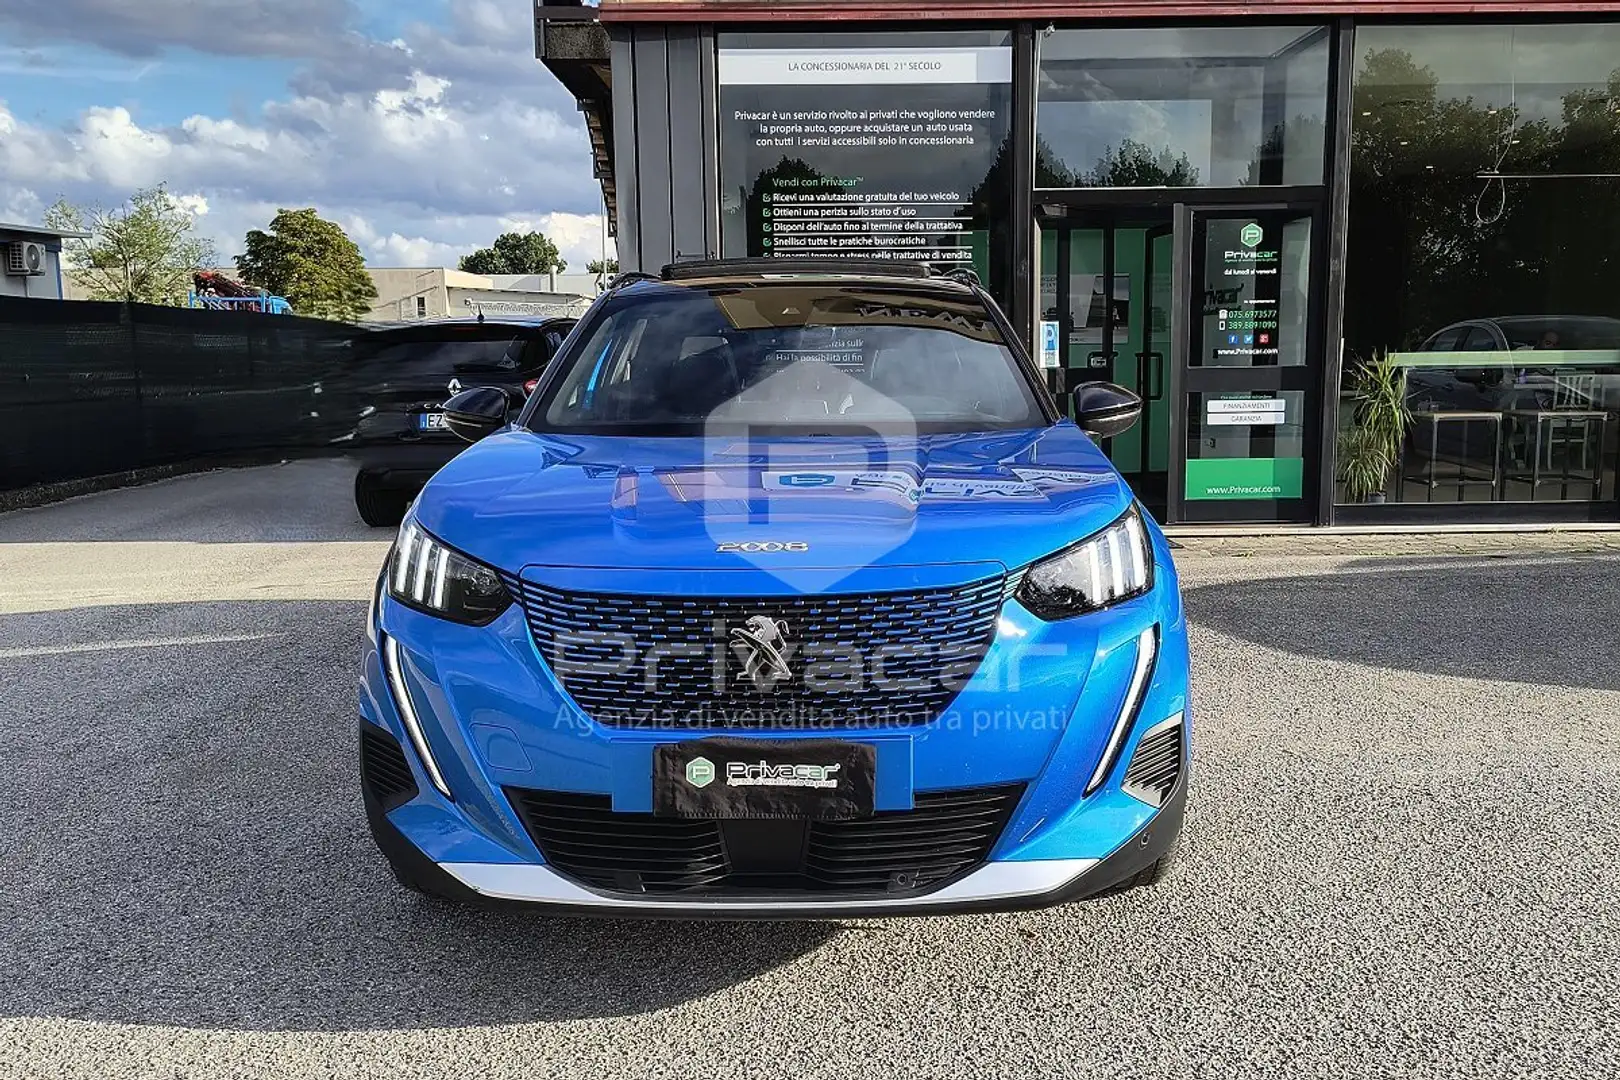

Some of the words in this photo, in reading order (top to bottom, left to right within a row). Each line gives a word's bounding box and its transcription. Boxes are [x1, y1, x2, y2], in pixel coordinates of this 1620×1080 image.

[788, 62, 799, 71] LA
[800, 61, 873, 71] CONCESSIONARIA
[874, 61, 890, 70] DEL
[908, 61, 942, 70] SECOLO
[734, 110, 771, 120] Privacar
[772, 111, 778, 120] è
[780, 112, 792, 120] un
[793, 111, 828, 120] servizio
[828, 110, 858, 120] rivolto
[858, 110, 868, 119] ai
[869, 109, 898, 121] privati
[899, 109, 916, 119] che
[917, 109, 957, 121] vogliono
[958, 109, 996, 119] vendere
[760, 123, 768, 133] la
[770, 123, 802, 134] propria
[804, 123, 828, 133] auto,
[828, 124, 862, 134] oppure
[862, 123, 910, 134] acquistare
[911, 124, 923, 132] un
[926, 123, 948, 132] auto
[948, 123, 973, 132] usata
[756, 138, 773, 146] con
[774, 136, 794, 146] tutti
[802, 136, 830, 146] servizi
[832, 136, 876, 146] accessibili
[878, 136, 898, 145] solo
[899, 136, 907, 145] in
[908, 135, 974, 145] concessionaria
[772, 177, 799, 187] Vendi
[800, 179, 818, 187] con
[772, 193, 798, 202] Ricevi
[816, 192, 864, 201] valutazione
[864, 192, 898, 202] gratuita
[899, 192, 912, 201] del
[914, 192, 928, 201] tuo
[930, 192, 960, 201] veicolo
[773, 207, 802, 216] Ottieni
[820, 207, 848, 218] perizia
[849, 206, 870, 216] sullo
[870, 206, 892, 216] stato
[774, 222, 804, 233] Disponi
[806, 222, 842, 231] dell'auto
[844, 222, 860, 231] fino
[861, 222, 870, 231] al
[870, 222, 902, 231] termine
[904, 222, 924, 231] della
[926, 222, 963, 230] trattativa
[774, 237, 806, 246] Snellisci
[808, 237, 828, 246] tutte
[829, 236, 838, 246] le
[838, 236, 873, 247] pratiche
[874, 236, 926, 246] burocratiche
[892, 250, 930, 260] trattative
[932, 250, 940, 259] di
[941, 250, 972, 259] vendita
[1224, 250, 1278, 259] Privacar
[1228, 310, 1278, 319] 075.6973577
[1206, 486, 1281, 494] www.Privacar.com
[716, 541, 809, 553] 2008
